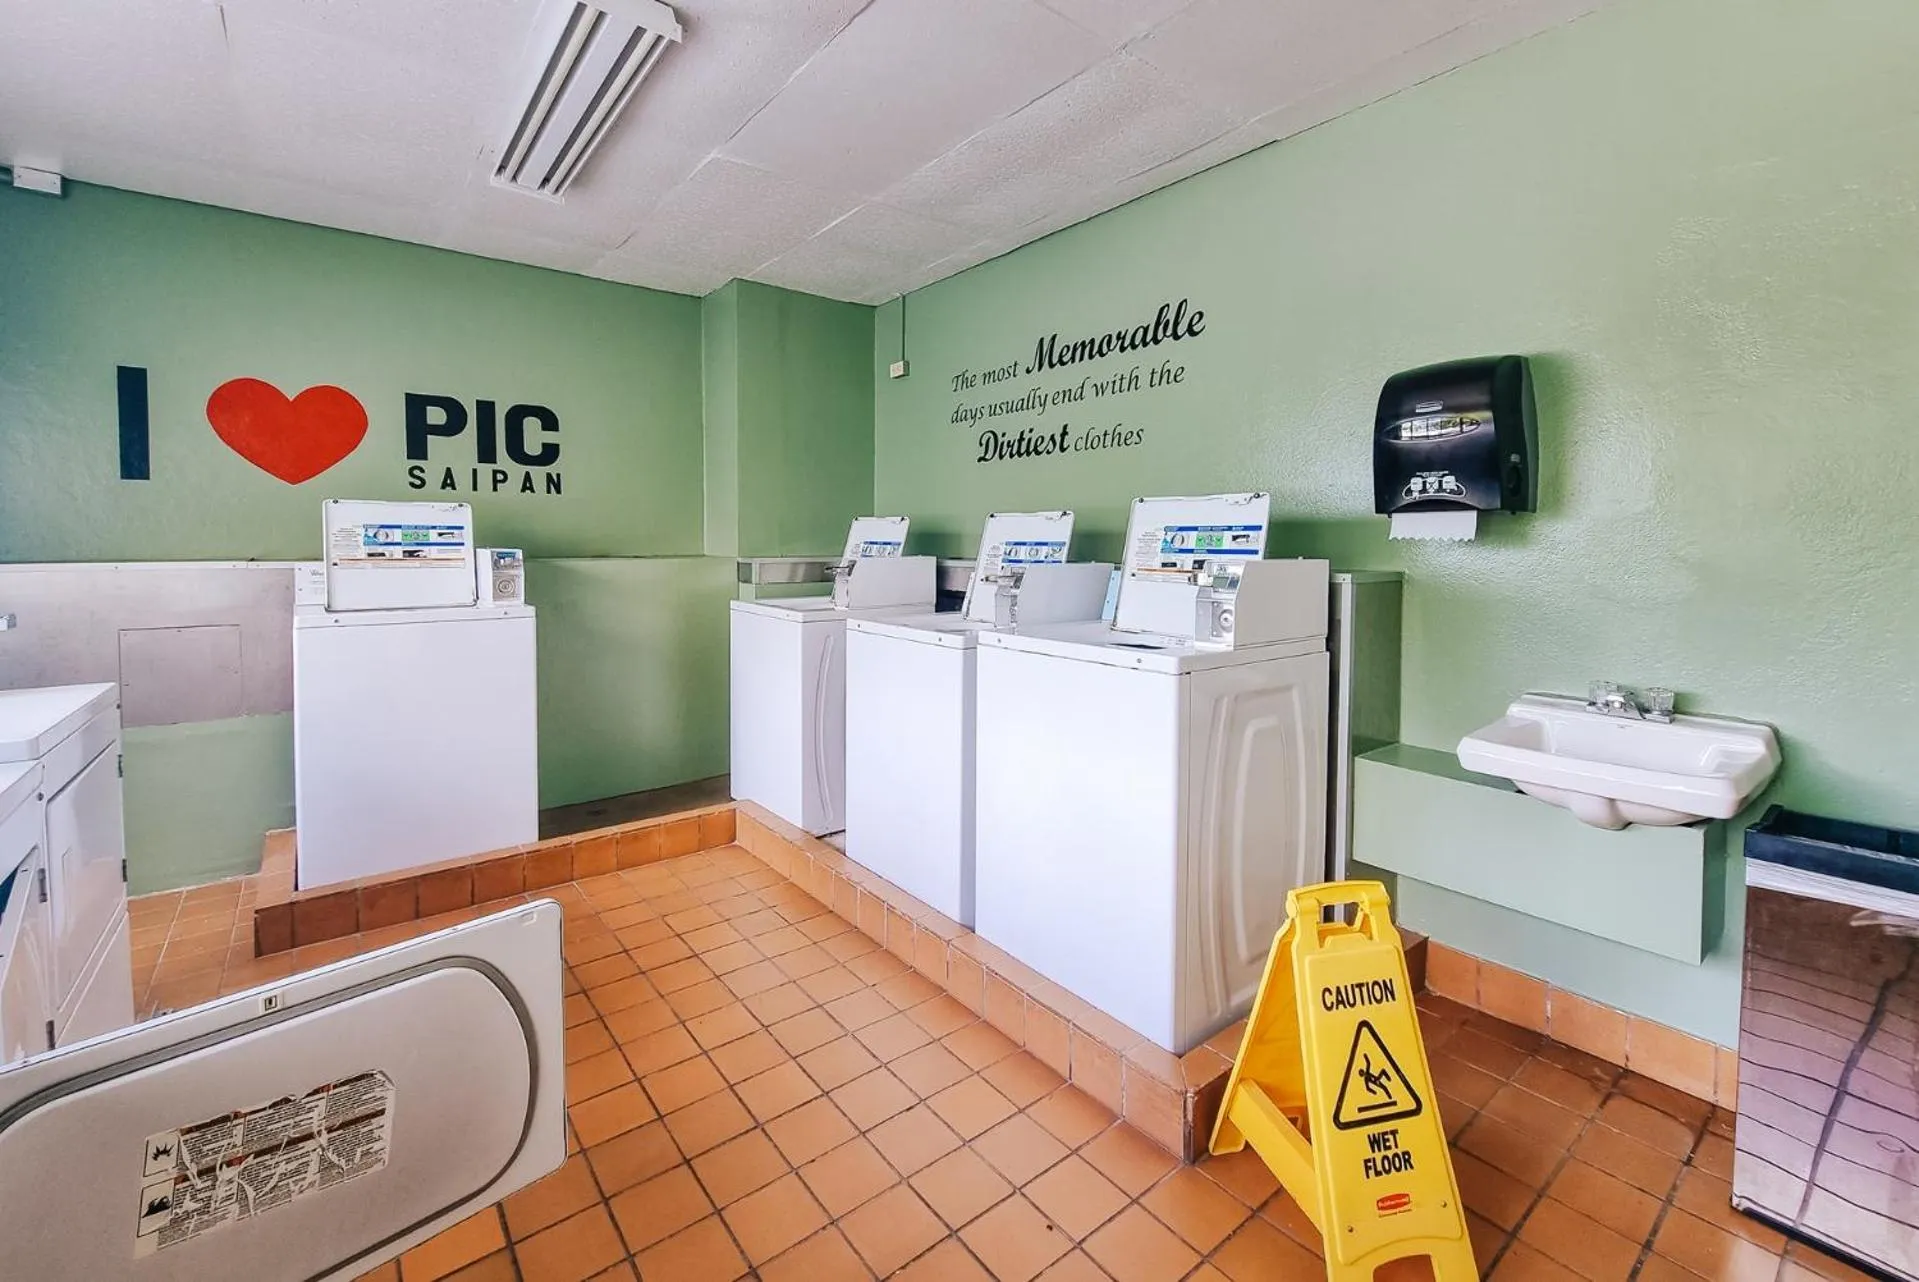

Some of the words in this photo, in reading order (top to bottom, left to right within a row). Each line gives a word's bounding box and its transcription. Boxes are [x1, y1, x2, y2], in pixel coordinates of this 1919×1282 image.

[951, 368, 977, 393] The
[982, 360, 1021, 386] most
[1025, 298, 1206, 375] Memorable
[951, 403, 985, 428] days
[988, 387, 1048, 416] usually
[1052, 376, 1091, 406] end
[1091, 366, 1140, 398] with
[1149, 359, 1185, 388] the
[117, 365, 151, 481] I
[404, 392, 561, 467] PIC
[977, 423, 1071, 463] Dirtiest
[1074, 422, 1144, 452] clothes
[407, 465, 563, 495] SAIPAN
[1321, 978, 1396, 1012] CAUTION
[1367, 1129, 1399, 1153] WET
[1363, 1150, 1414, 1179] FLOOR
